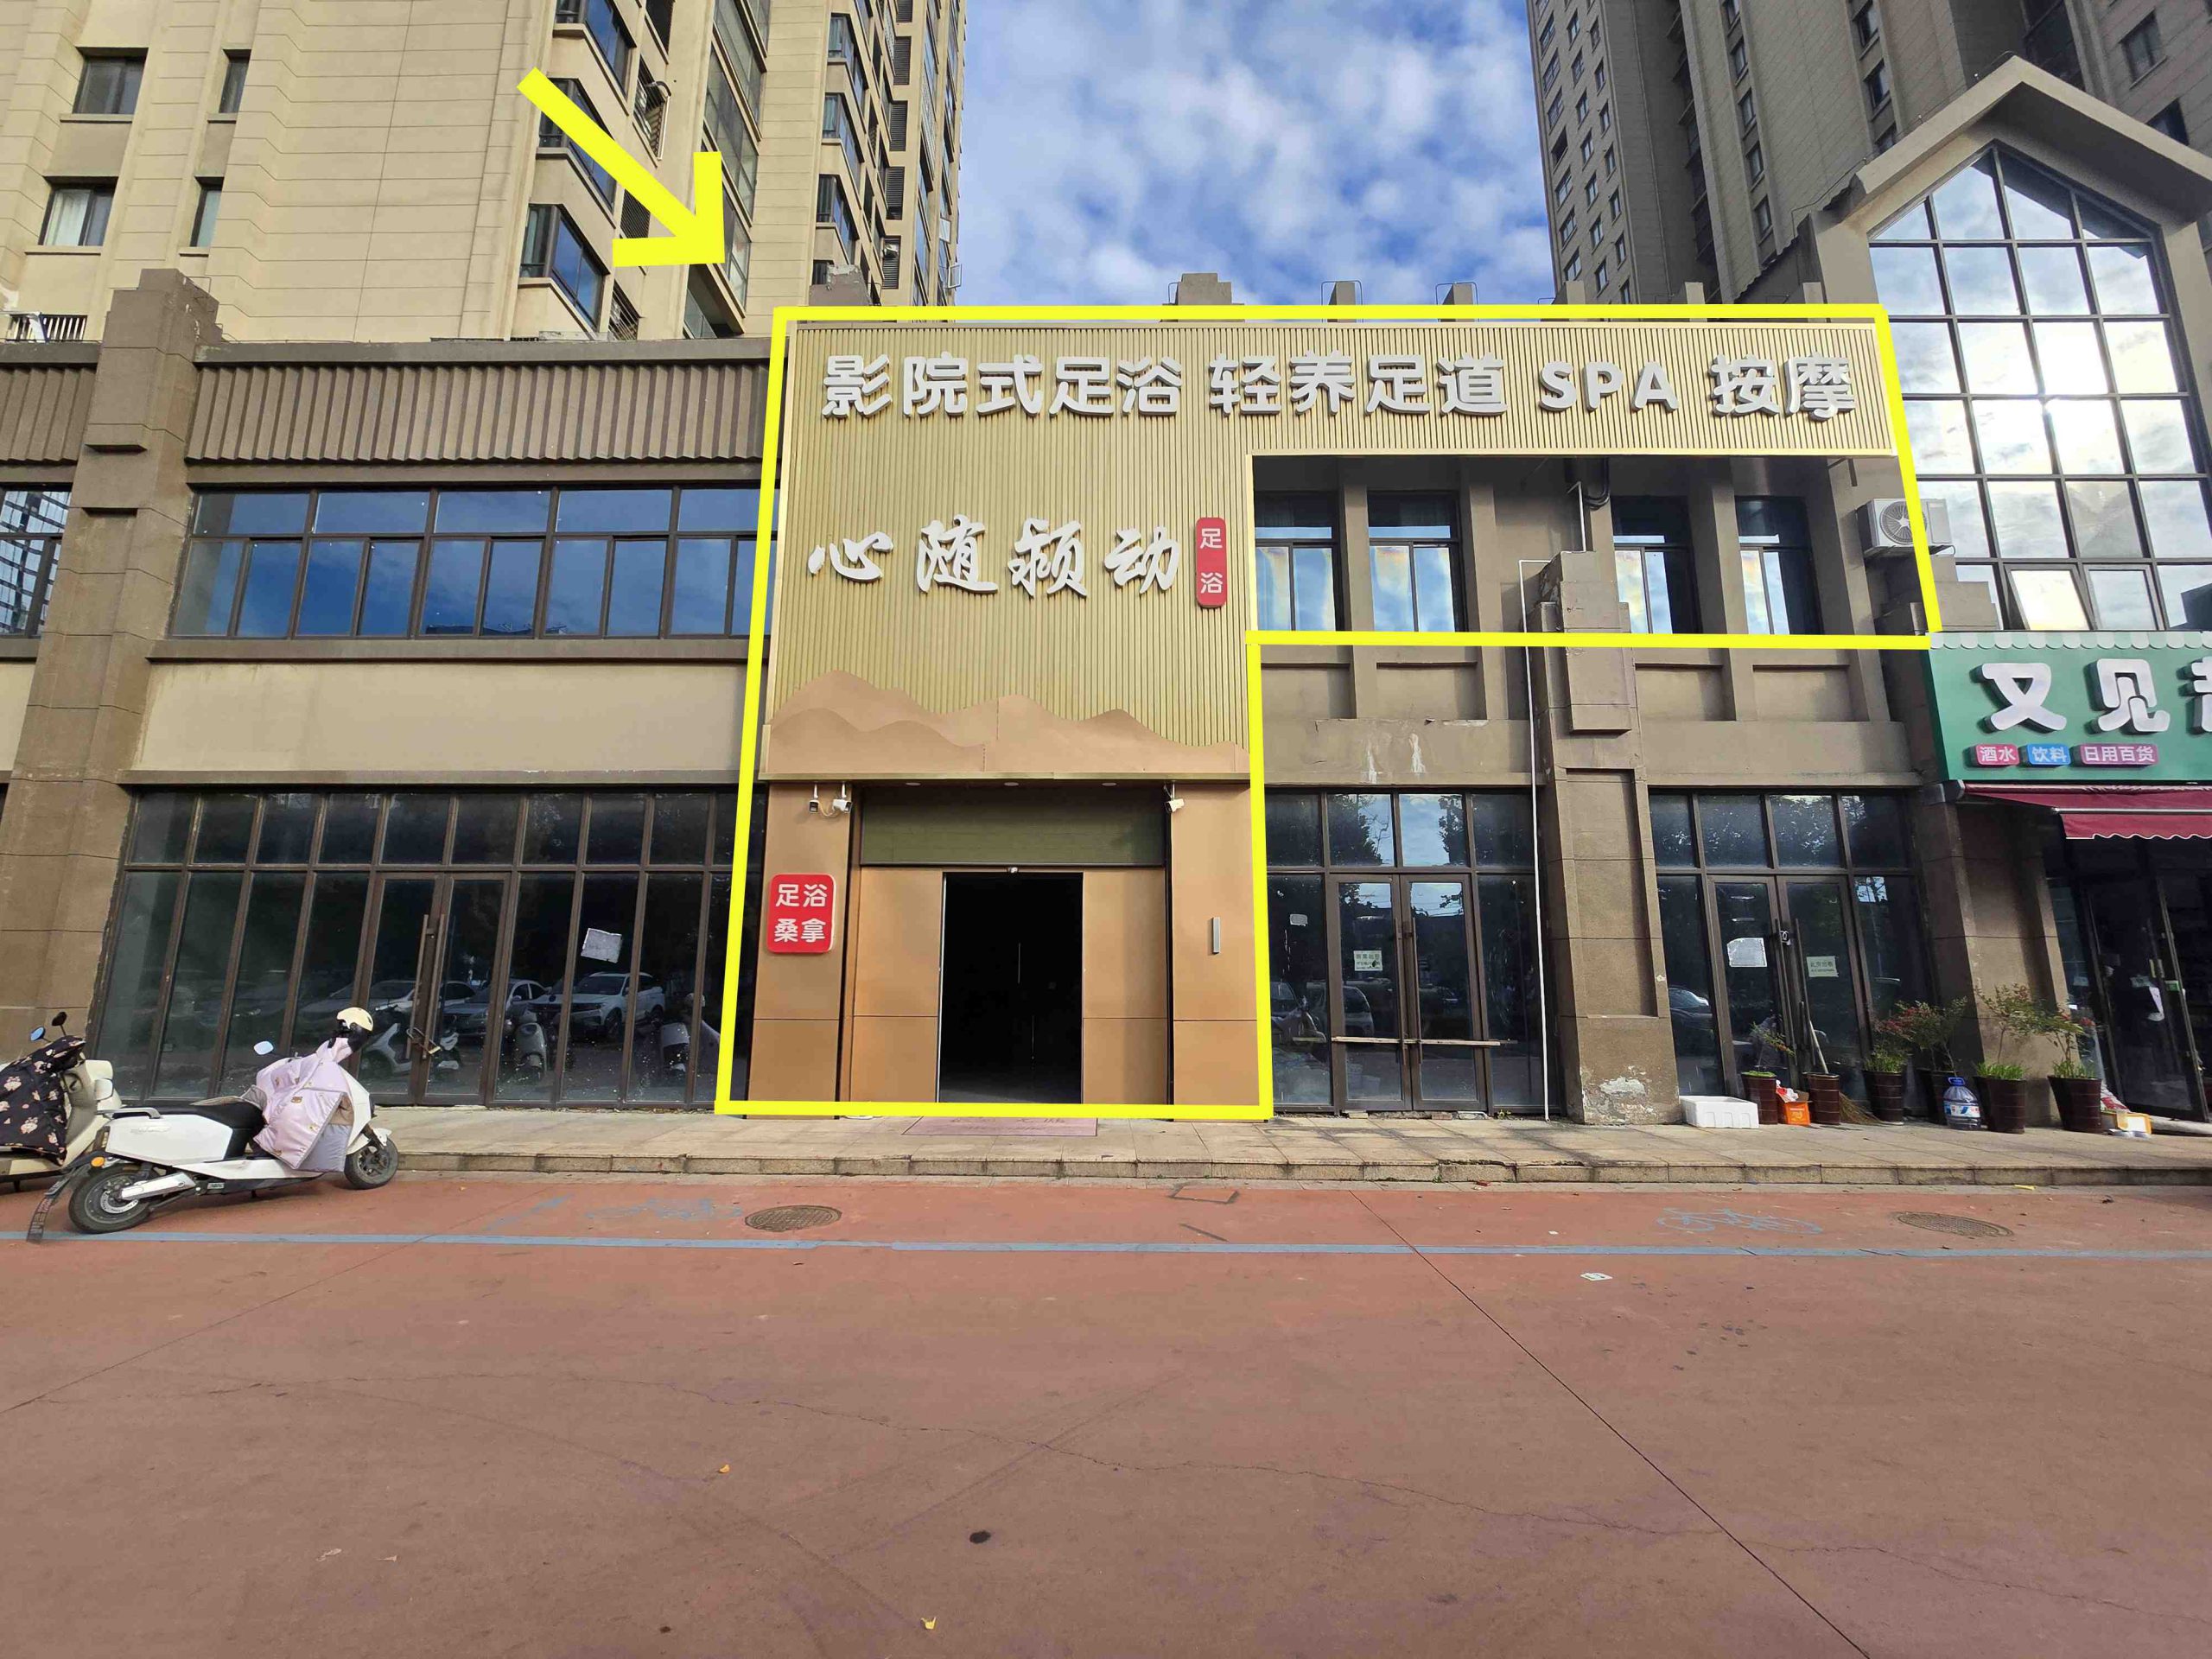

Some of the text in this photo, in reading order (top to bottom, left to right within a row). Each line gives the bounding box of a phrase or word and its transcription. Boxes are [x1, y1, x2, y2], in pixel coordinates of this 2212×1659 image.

[823, 350, 1858, 422] 影院式足浴 轻养足道 SPA 按摩
[1199, 528, 1224, 594] 足浴
[1979, 745, 2018, 763] 酒水
[2031, 746, 2069, 764] 饮料
[2083, 745, 2156, 764] 日用百货
[775, 883, 828, 907] 足浴
[773, 918, 827, 944] 桑拿
